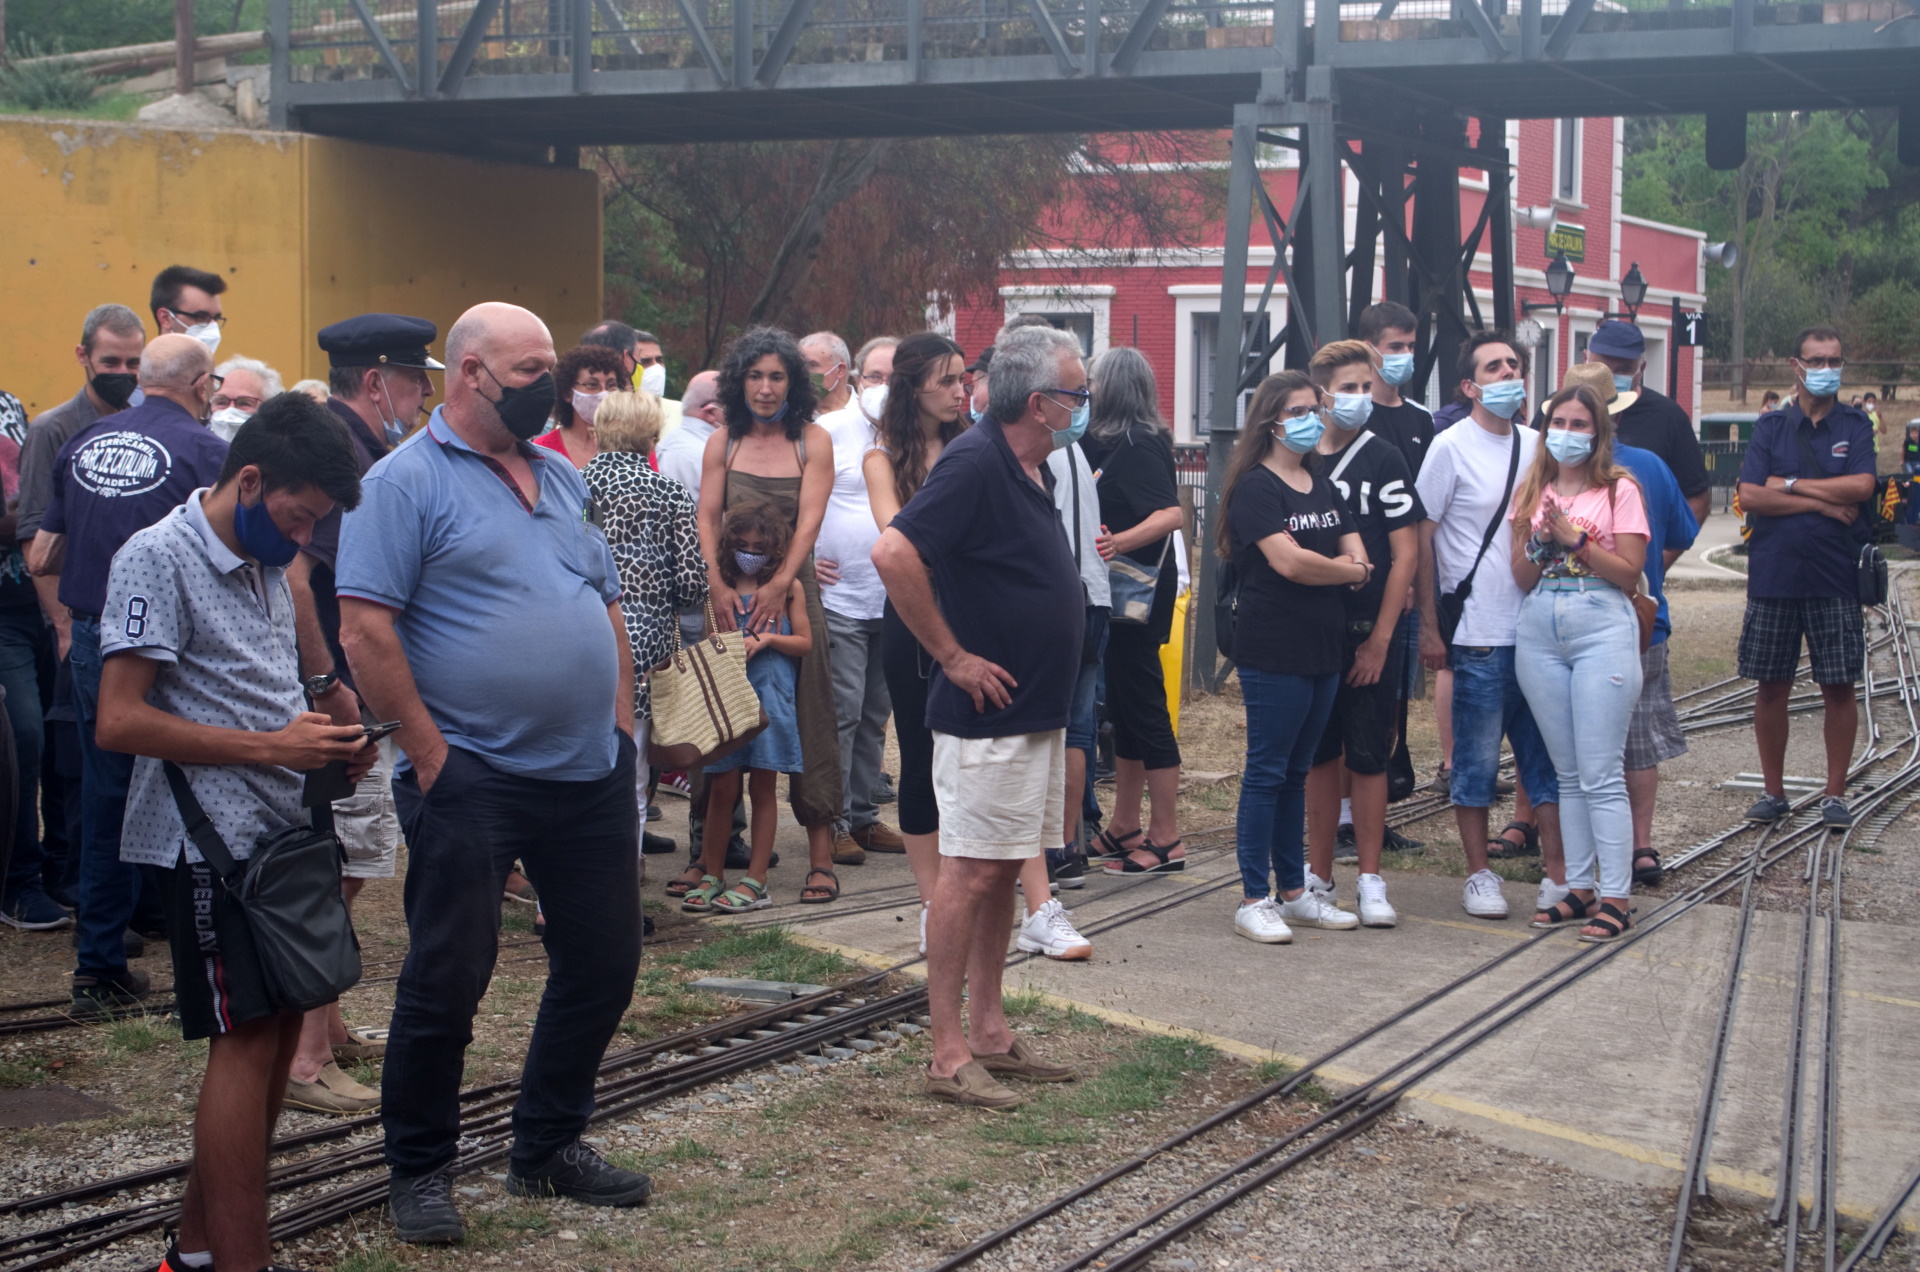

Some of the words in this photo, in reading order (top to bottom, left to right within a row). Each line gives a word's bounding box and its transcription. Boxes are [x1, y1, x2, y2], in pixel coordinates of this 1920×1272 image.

[1685, 312, 1703, 321] VIA
[1686, 320, 1696, 345] 1
[93, 438, 157, 458] FERROCARRIL
[78, 448, 105, 471] PARC
[98, 447, 119, 473] DE
[110, 448, 158, 479] CATALUNYA
[85, 470, 140, 487] SABADELL
[1284, 512, 1320, 531] OMM
[1563, 515, 1606, 545] ROUBLE
[125, 595, 149, 639] 8
